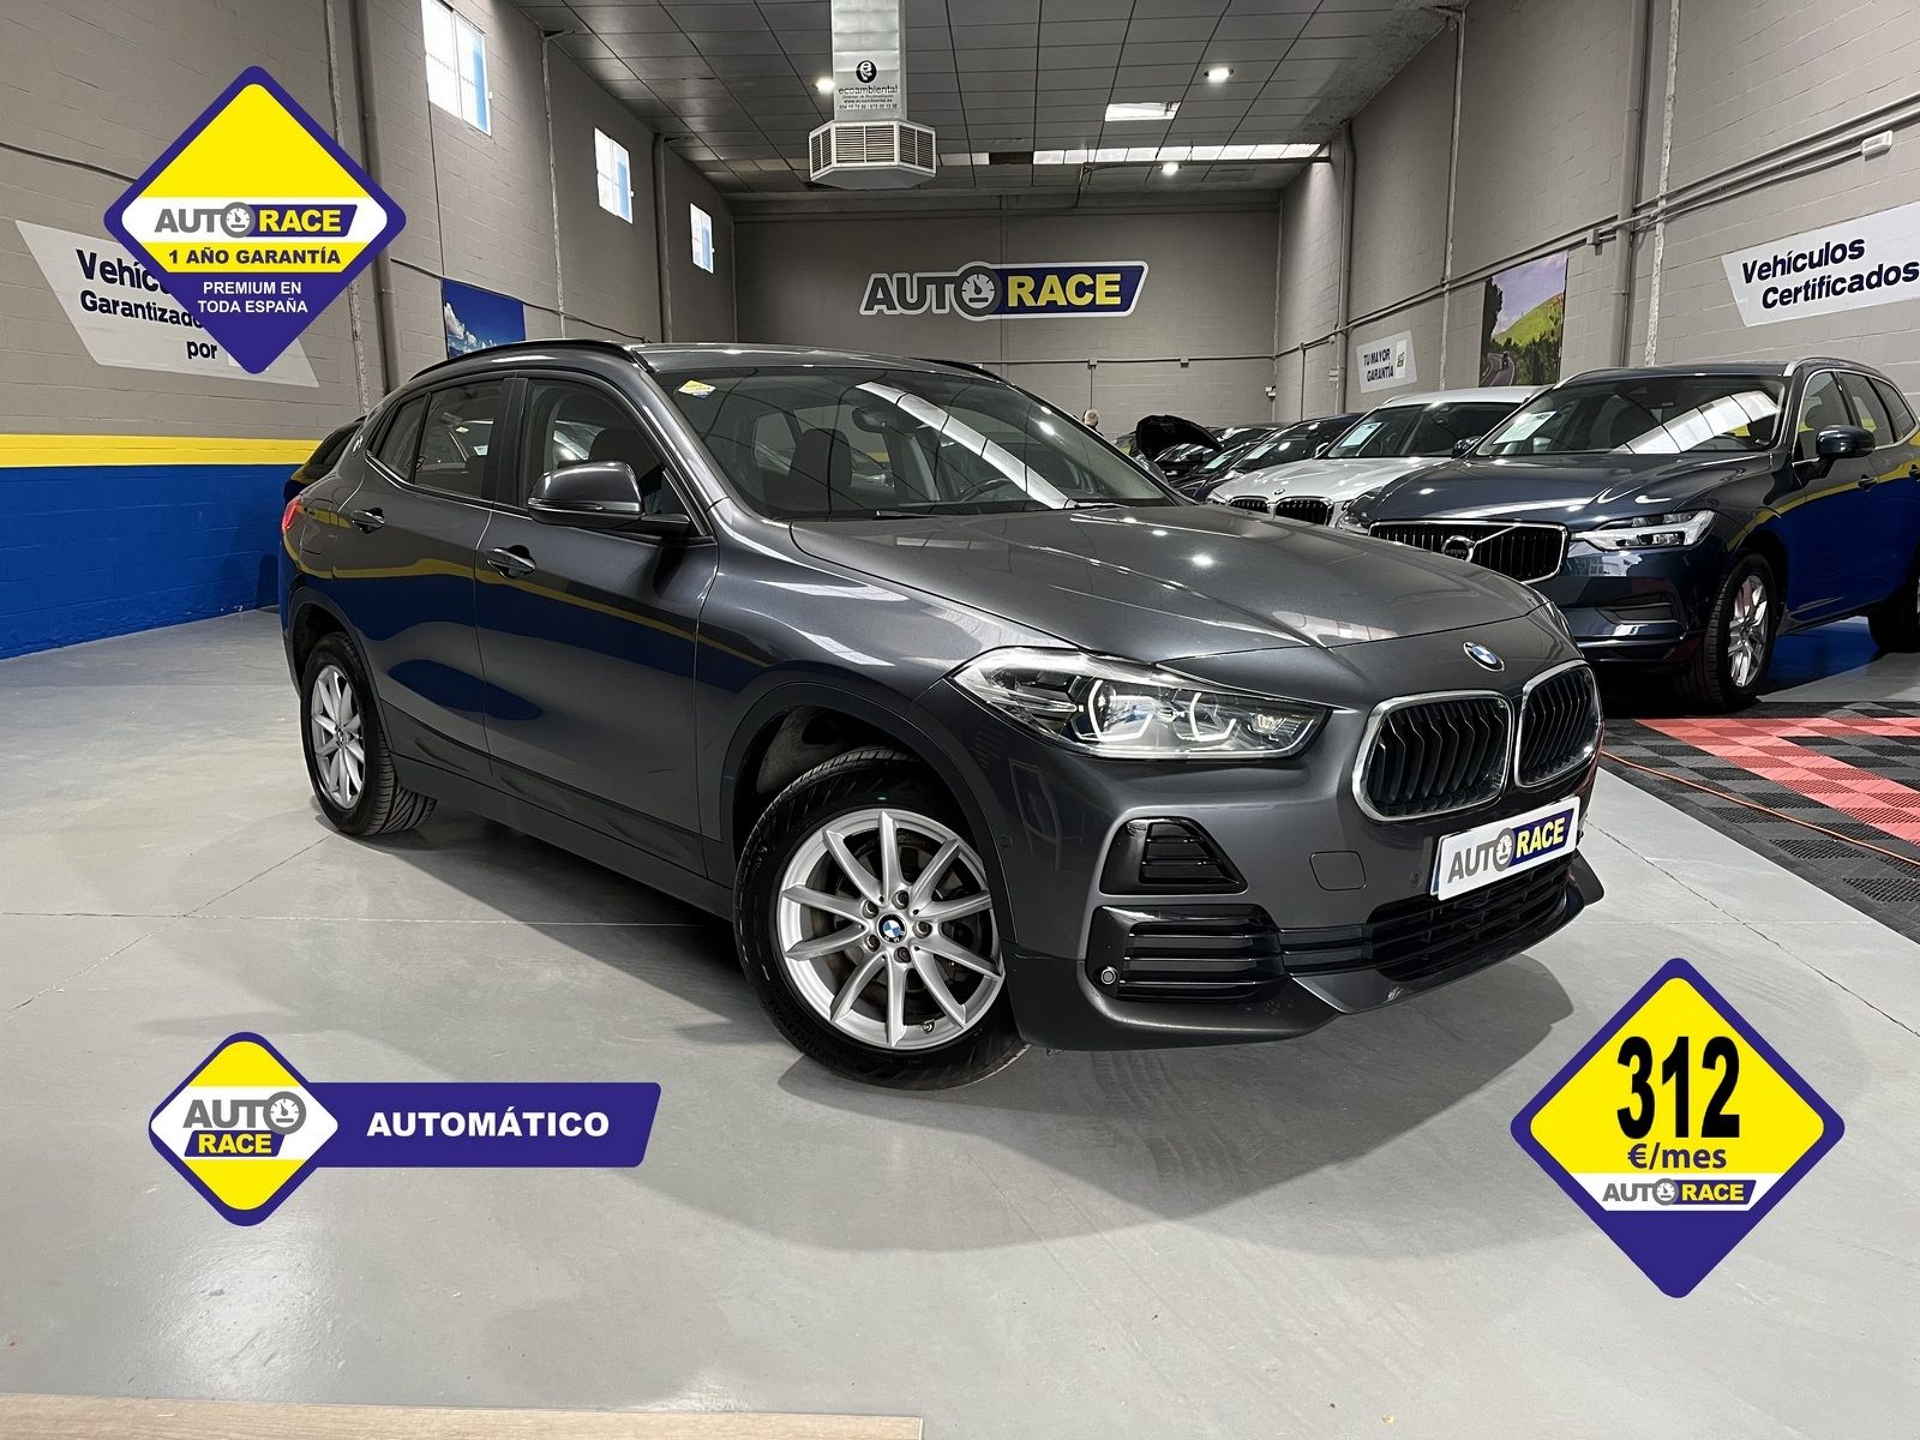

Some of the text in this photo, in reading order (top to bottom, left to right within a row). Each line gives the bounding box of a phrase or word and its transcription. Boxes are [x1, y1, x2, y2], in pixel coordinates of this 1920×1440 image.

[838, 84, 898, 95] ecoambiental
[1742, 238, 1865, 284] Vehículos
[862, 263, 1122, 318] AUTO RACE
[1762, 261, 1920, 309] Certificados
[186, 341, 218, 360] por
[1447, 817, 1566, 884] AUTO RACE
